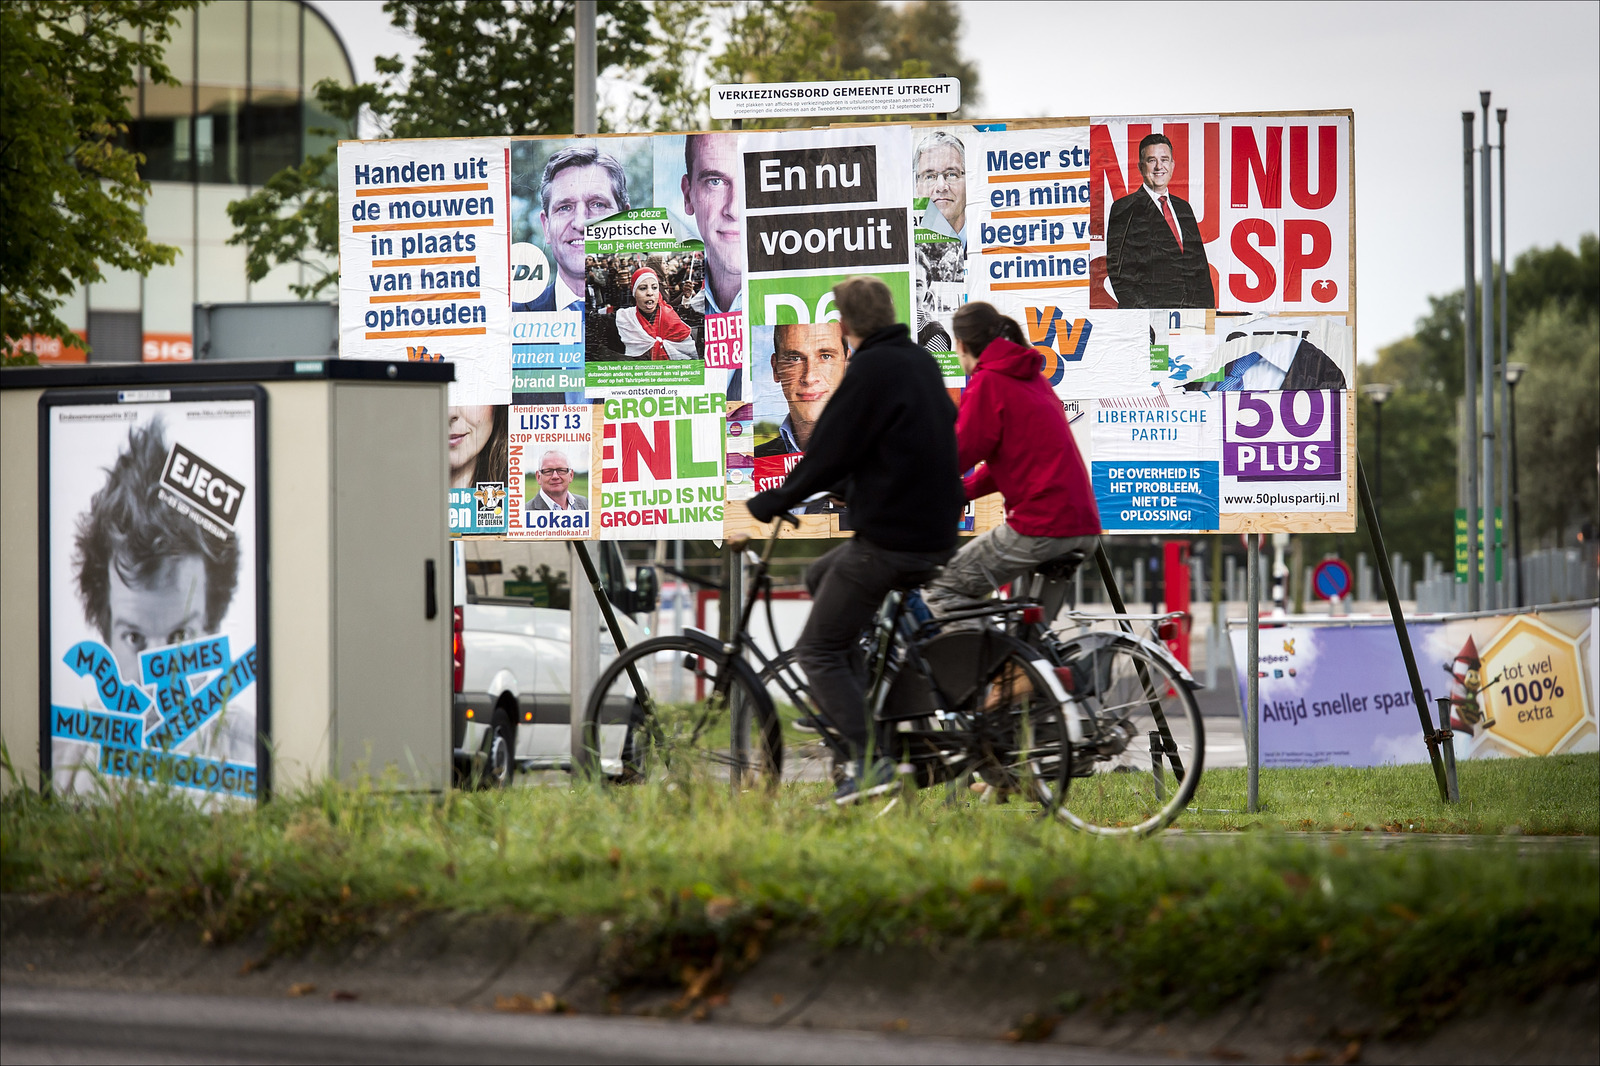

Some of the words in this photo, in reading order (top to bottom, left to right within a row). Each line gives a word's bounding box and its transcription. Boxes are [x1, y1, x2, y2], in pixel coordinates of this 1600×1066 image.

[718, 88, 829, 100] VERKIEZINGSBORD
[833, 86, 894, 97] GEMEENTE
[897, 84, 951, 95] UTRECHT
[800, 98, 844, 107] verkiezingsborden
[354, 160, 446, 186] Handen
[453, 156, 489, 180] uit
[986, 150, 1051, 172] Meer
[1230, 125, 1338, 211] NU
[758, 158, 807, 193] En
[815, 161, 862, 190] nu
[351, 199, 381, 221] de
[388, 195, 495, 219] mouwen
[990, 188, 1021, 208] en
[627, 211, 638, 220] op
[640, 208, 661, 218] deze
[586, 222, 657, 240] Egyptische
[759, 216, 893, 257] vooruit
[980, 219, 1065, 247] begrip
[371, 233, 393, 256] in
[401, 230, 477, 259] plaats
[597, 241, 614, 250] kan
[615, 242, 624, 252] je
[626, 240, 644, 250] niet
[511, 263, 544, 282] DA
[989, 253, 1091, 280] crimine
[368, 272, 413, 292] van
[420, 265, 481, 290] hand
[364, 302, 487, 332] ophouden
[511, 320, 577, 339] amen
[559, 351, 582, 364] we
[611, 386, 678, 398] www.ontstemd.org
[513, 404, 544, 413] Hendrie
[549, 405, 560, 413] van
[562, 403, 588, 413] Assem
[603, 392, 727, 420] GROENER
[1097, 409, 1208, 424] LIBERTARISCHE
[1234, 389, 1325, 440] 50
[520, 414, 560, 430] LIJST
[564, 413, 581, 429] 13
[509, 433, 533, 443] STOP
[534, 432, 592, 443] VERSPILLING
[1131, 427, 1178, 442] PARTIJ
[602, 416, 727, 484] ENL
[1237, 444, 1322, 473] PLUS
[168, 451, 242, 516] EJECT
[1107, 467, 1125, 481] DE
[1126, 467, 1188, 481] OVERHEID
[1189, 467, 1201, 480] IS
[460, 490, 472, 505] je
[508, 445, 524, 529] Nederland
[601, 491, 627, 509] DE
[628, 488, 673, 507] TIJD
[675, 487, 695, 504] IS
[697, 485, 724, 503] NU
[1109, 481, 1134, 494] HET
[1135, 481, 1203, 496] PROBLEEM,
[1131, 496, 1158, 508] NIET
[1160, 496, 1178, 508] DE
[1223, 492, 1342, 507] www.50pluspartij.nl
[477, 512, 495, 521] PARTIJ
[477, 519, 485, 527] DE
[484, 519, 503, 527] DIEREN
[525, 511, 590, 529] Lokaal
[600, 505, 724, 528] GROENLINKS
[1120, 510, 1192, 523] OPLOSSING!
[508, 529, 590, 538] www.nederlandlokaal.nl
[148, 640, 224, 680] GAMES
[1501, 662, 1525, 682] tot
[1526, 654, 1553, 677] wel
[75, 644, 141, 714] MEDIA
[157, 679, 188, 714] EN
[1499, 674, 1565, 708] 100%
[1261, 697, 1308, 727] Altijd
[1311, 692, 1369, 718] sneller
[1516, 703, 1555, 724] extra
[55, 709, 139, 747] MUZIEK
